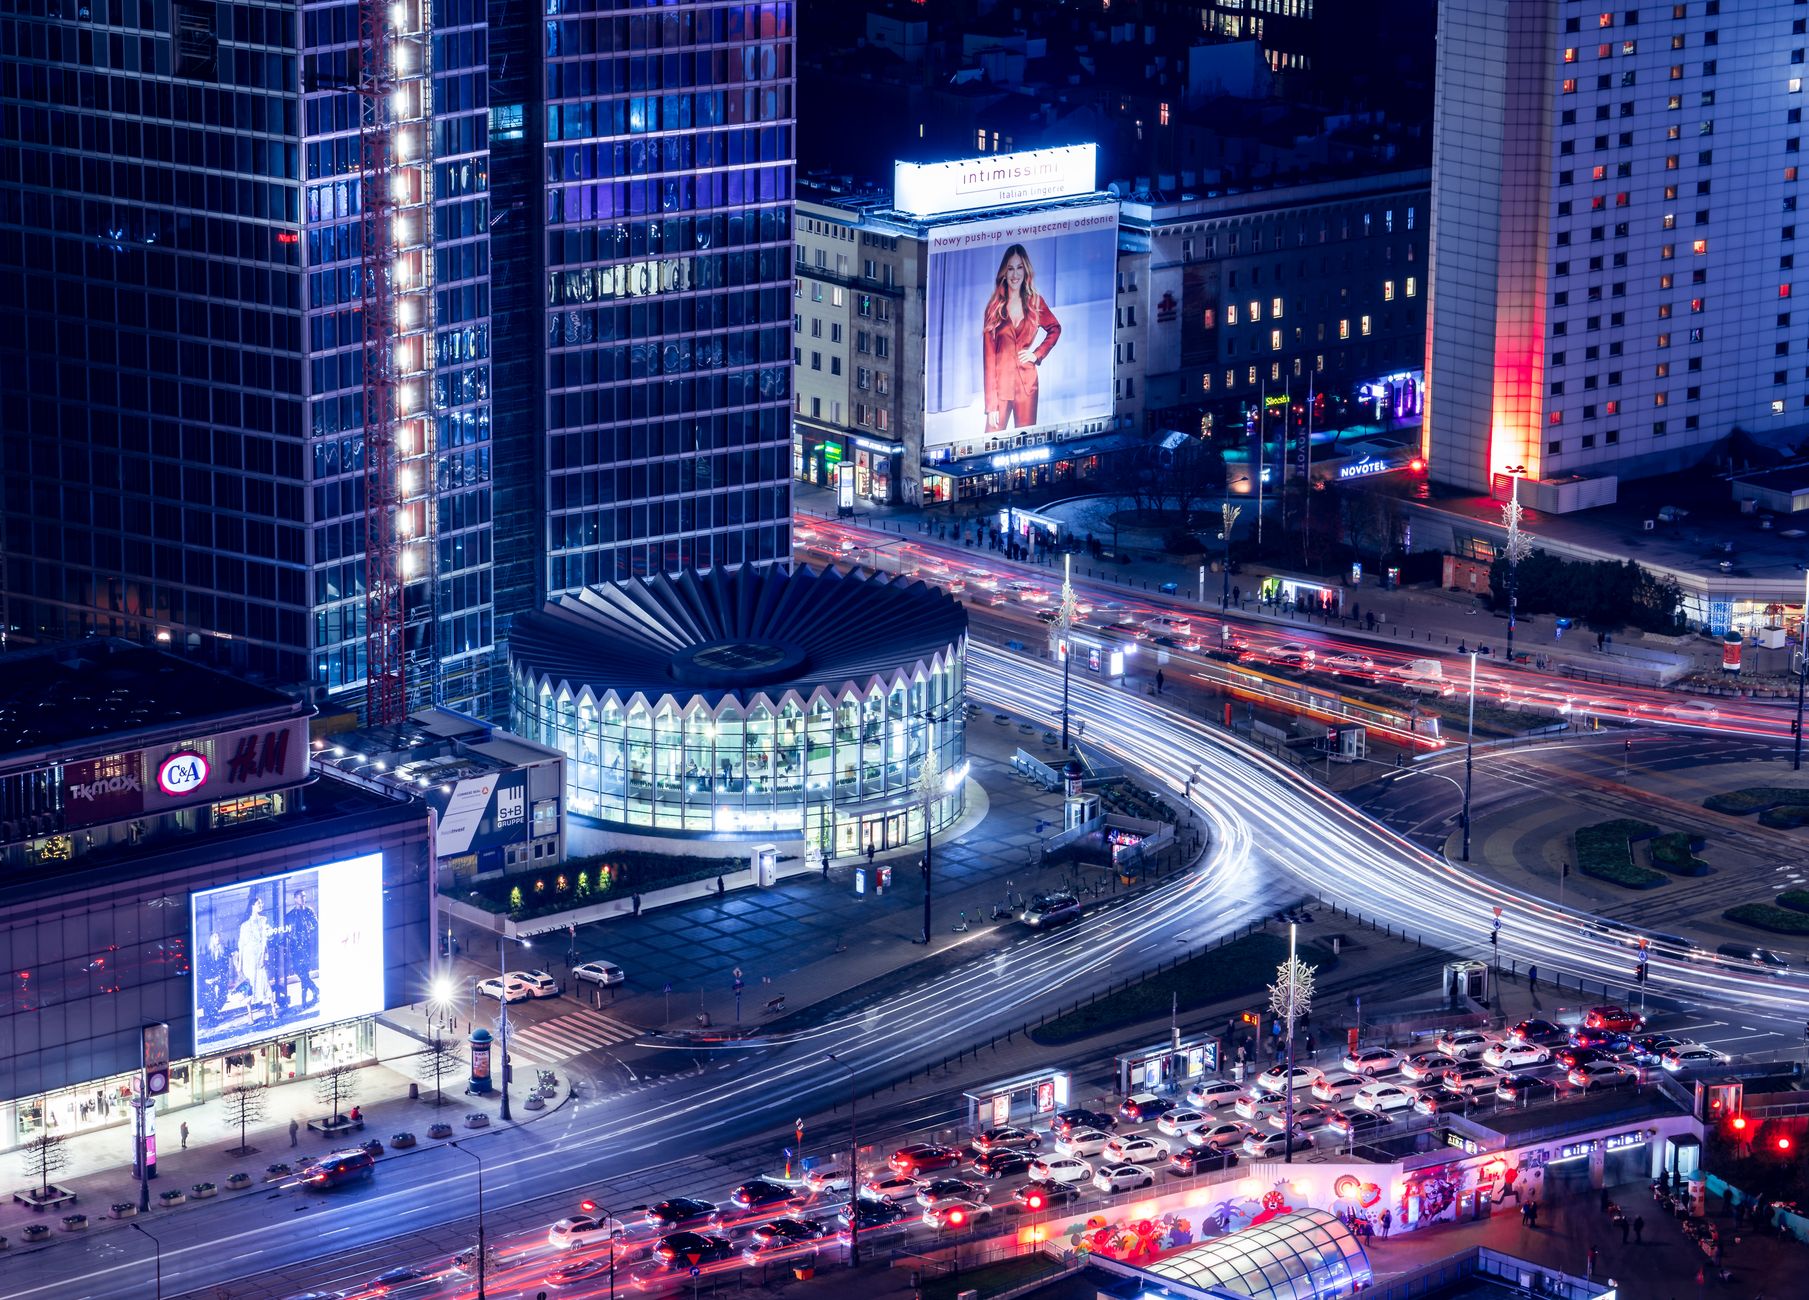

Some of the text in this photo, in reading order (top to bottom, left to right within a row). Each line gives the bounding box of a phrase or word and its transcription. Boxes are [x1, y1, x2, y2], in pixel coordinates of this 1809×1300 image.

[963, 162, 1058, 185] intimissimi
[999, 184, 1065, 200] Italian lingerie
[934, 215, 1114, 247] Nowy push-up w świątecznej odsłonie
[1341, 460, 1386, 477] NOVOTEL
[228, 729, 290, 784] H&M
[167, 761, 201, 785] C&A
[500, 805, 522, 819] S+B
[497, 817, 525, 828] GRUPPE
